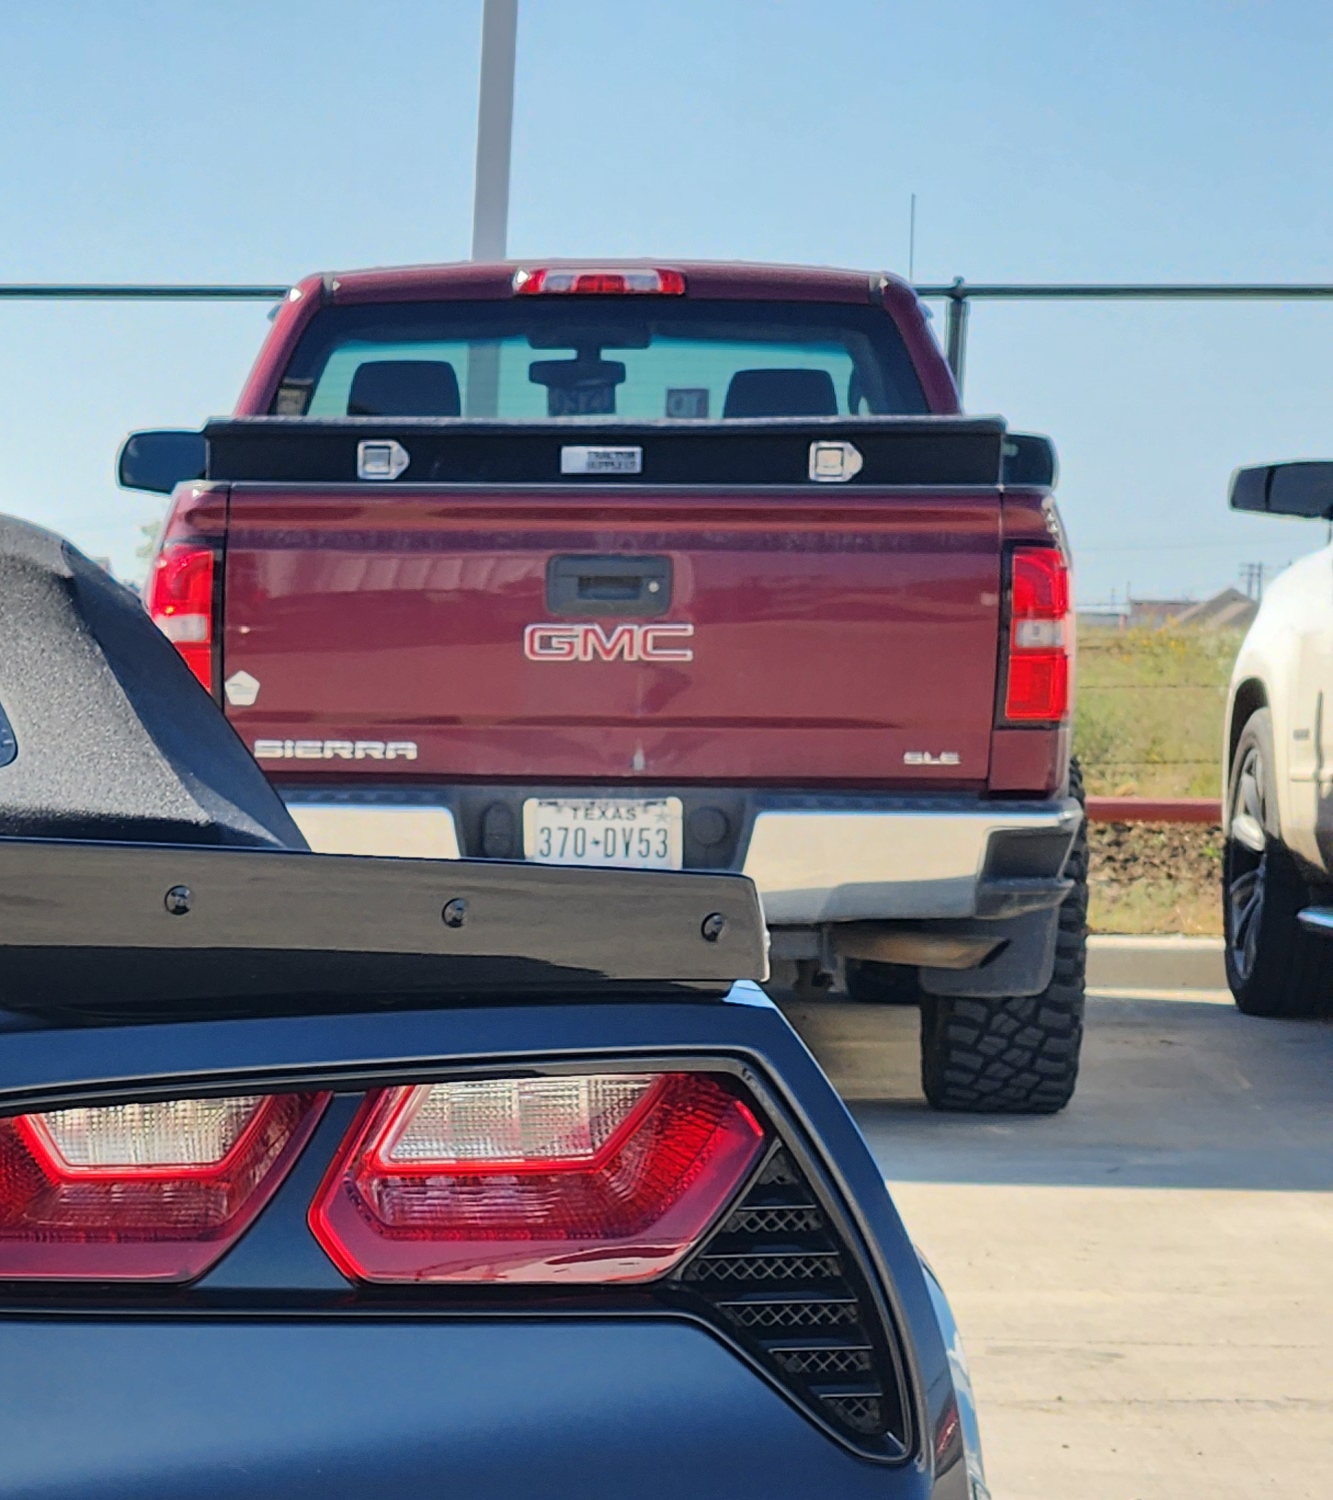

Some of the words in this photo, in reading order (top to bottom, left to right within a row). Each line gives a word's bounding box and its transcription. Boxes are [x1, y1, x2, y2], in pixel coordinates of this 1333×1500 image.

[523, 623, 695, 662] GMC
[253, 739, 418, 760] SIERRA
[569, 807, 638, 822] TEXAS
